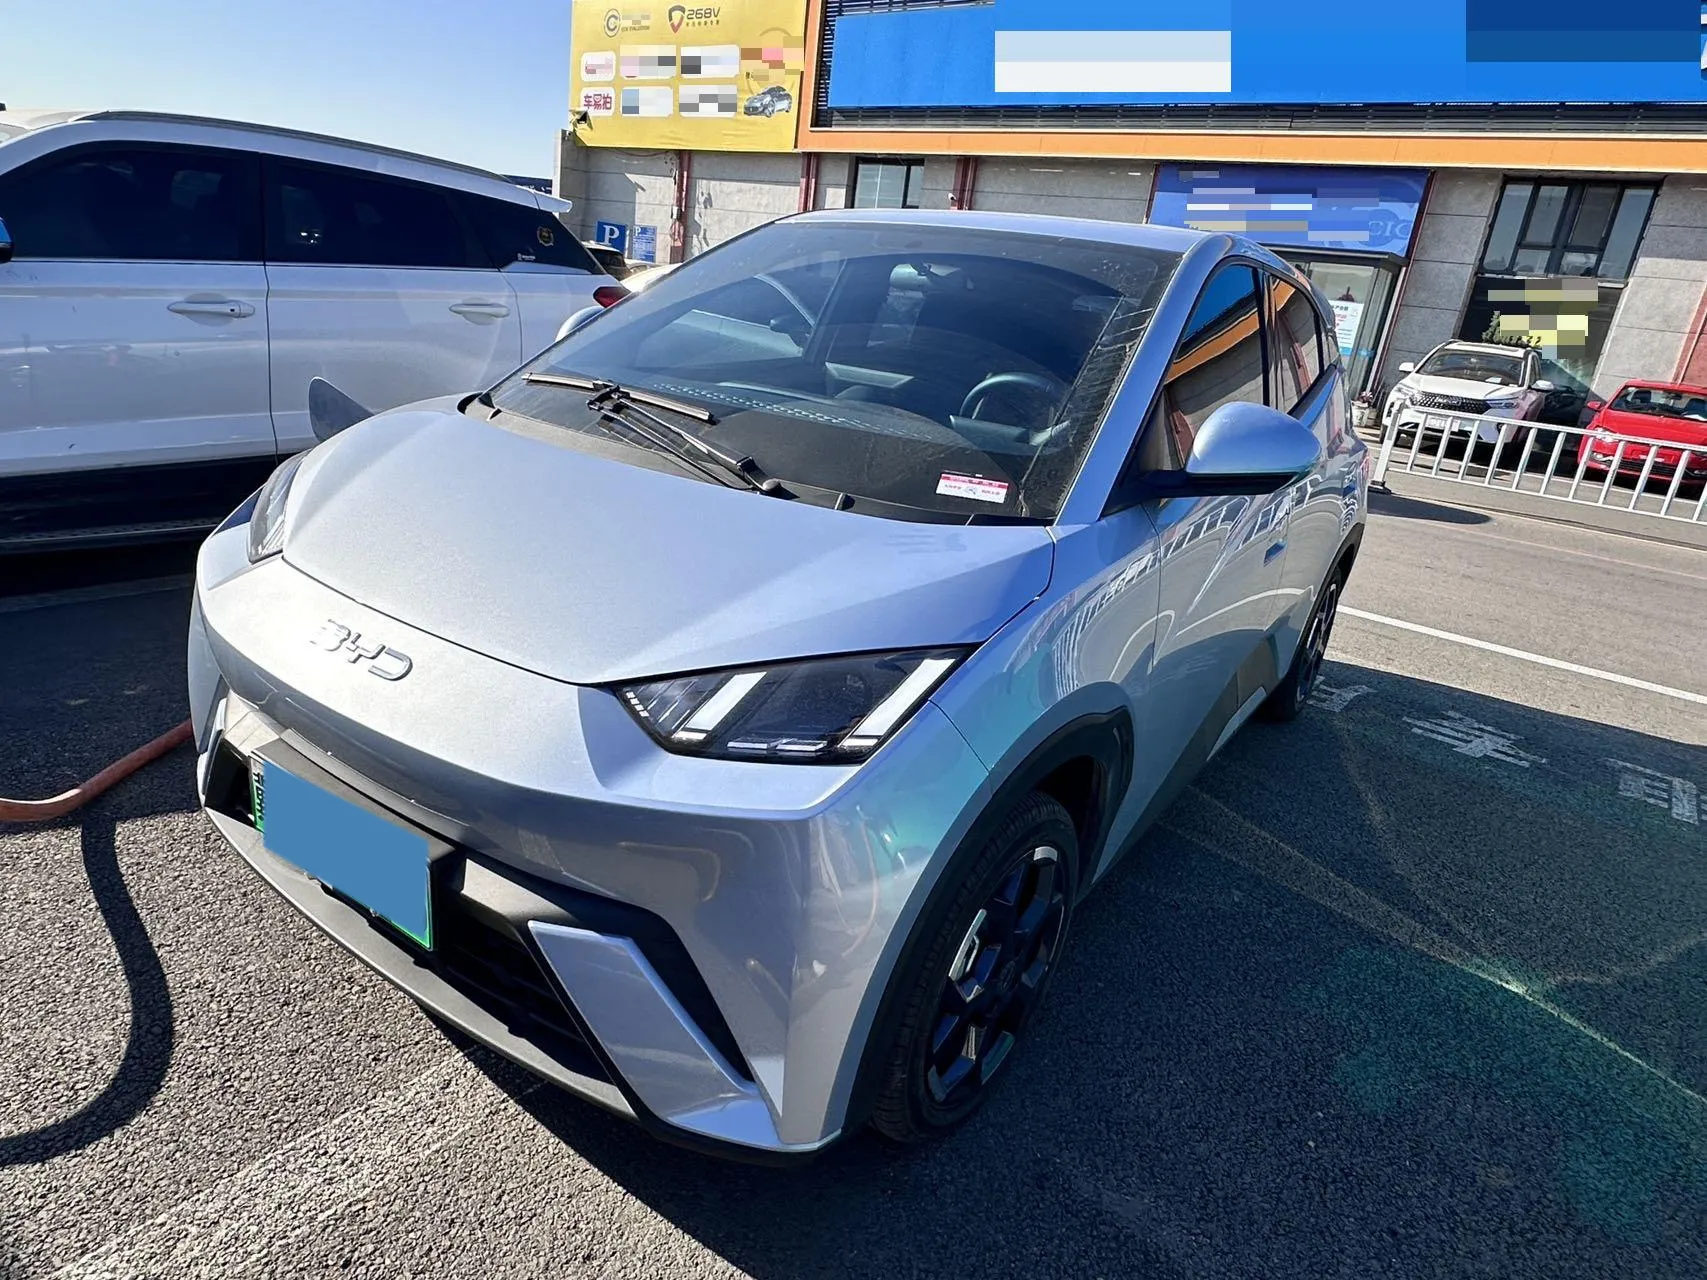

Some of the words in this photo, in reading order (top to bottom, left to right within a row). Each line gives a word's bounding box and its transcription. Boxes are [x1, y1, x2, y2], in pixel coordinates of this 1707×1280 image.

[687, 7, 720, 20] 268V
[584, 93, 612, 110] 车易拍
[603, 225, 620, 246] P
[635, 226, 642, 236] P
[308, 618, 413, 682] BYD
